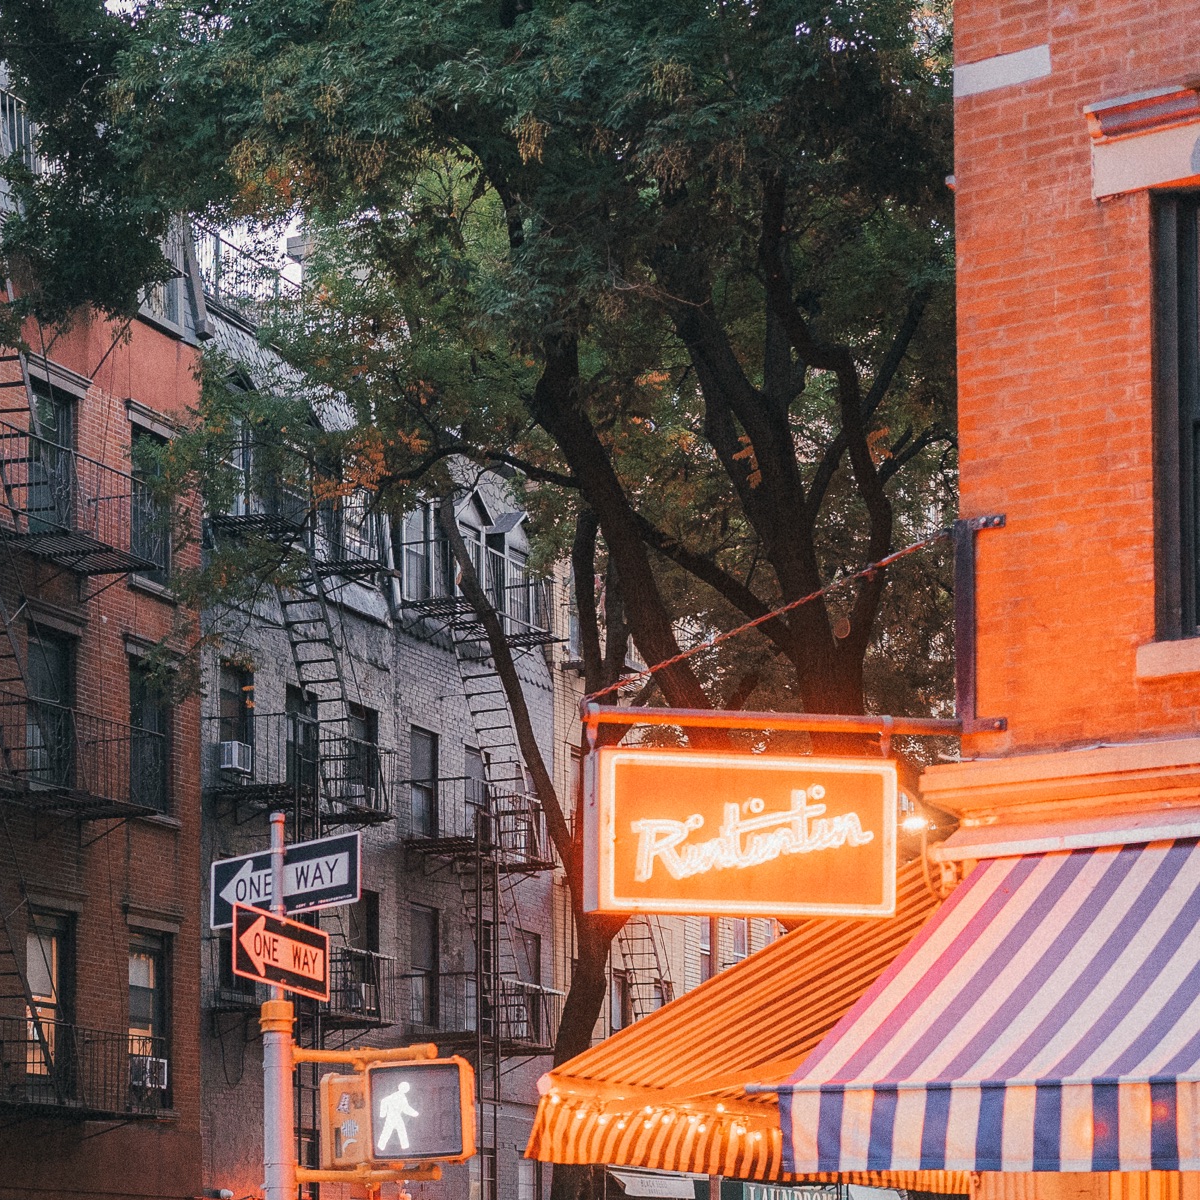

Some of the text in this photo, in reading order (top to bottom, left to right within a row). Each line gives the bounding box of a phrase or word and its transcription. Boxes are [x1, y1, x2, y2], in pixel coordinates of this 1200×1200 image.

[631, 783, 874, 882] Rintintin
[235, 858, 339, 902] ONE WAY
[253, 932, 318, 975] ONE WAY
